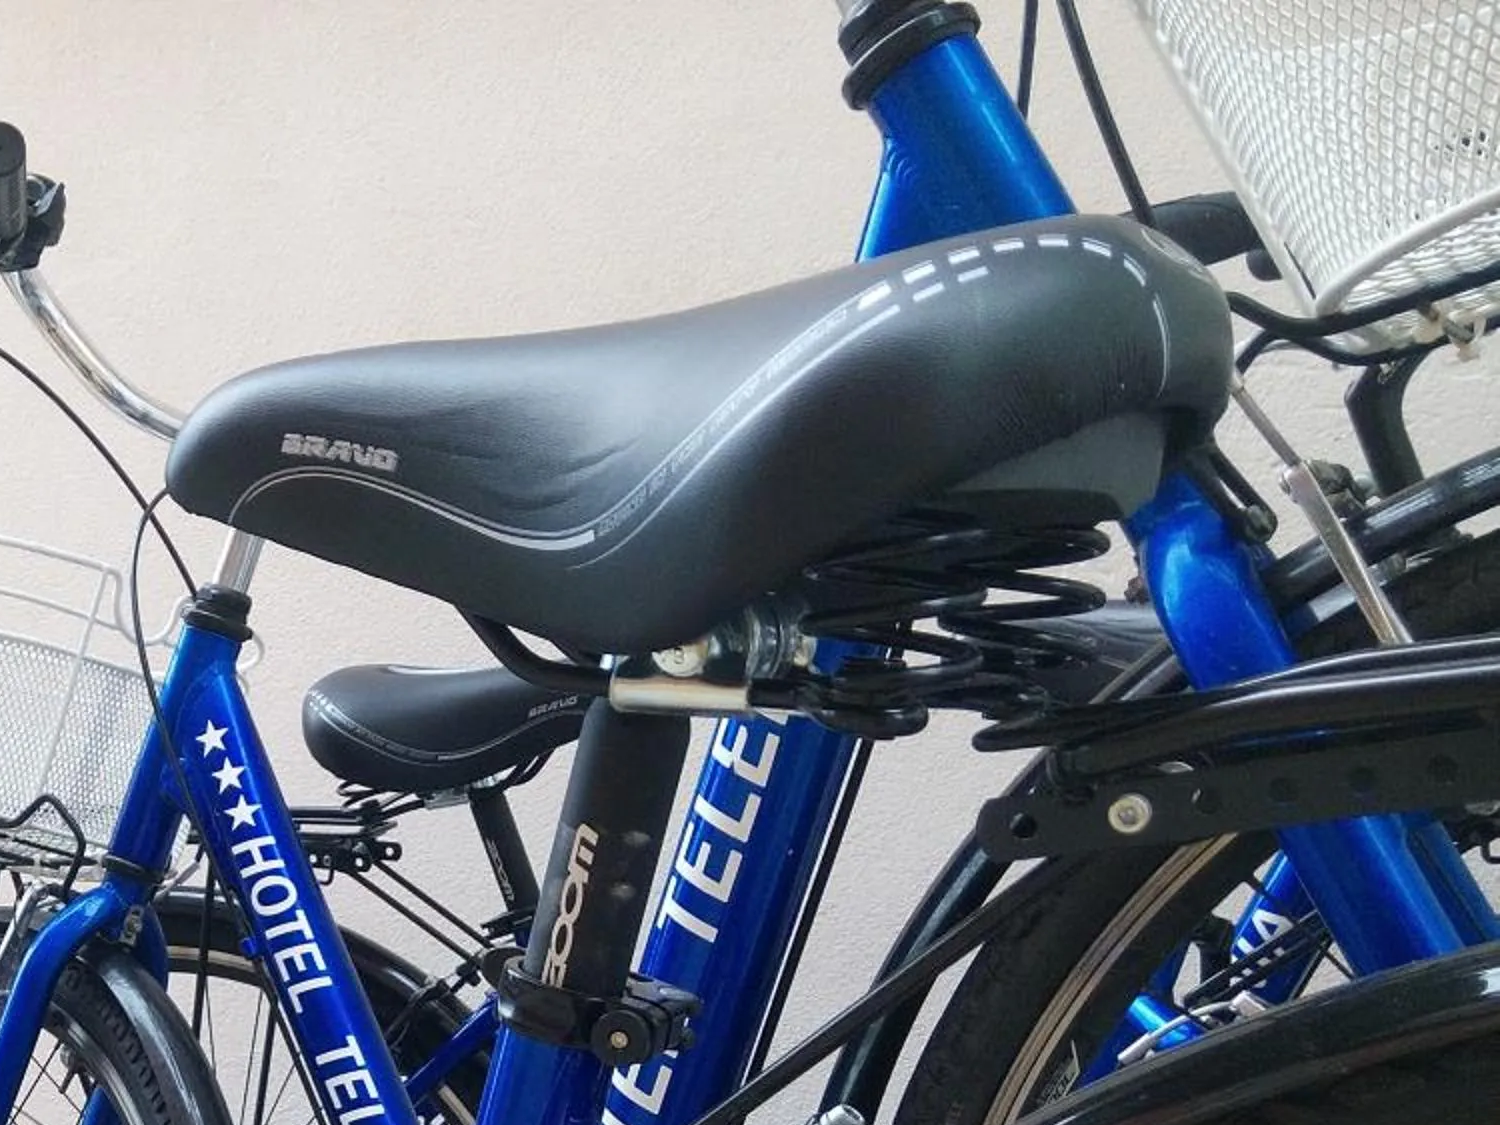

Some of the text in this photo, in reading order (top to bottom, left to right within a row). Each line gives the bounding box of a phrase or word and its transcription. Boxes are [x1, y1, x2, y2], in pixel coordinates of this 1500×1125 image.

[281, 433, 399, 472] BRAVO
[656, 705, 789, 943] TELE
[231, 834, 334, 1014] HOTEL
